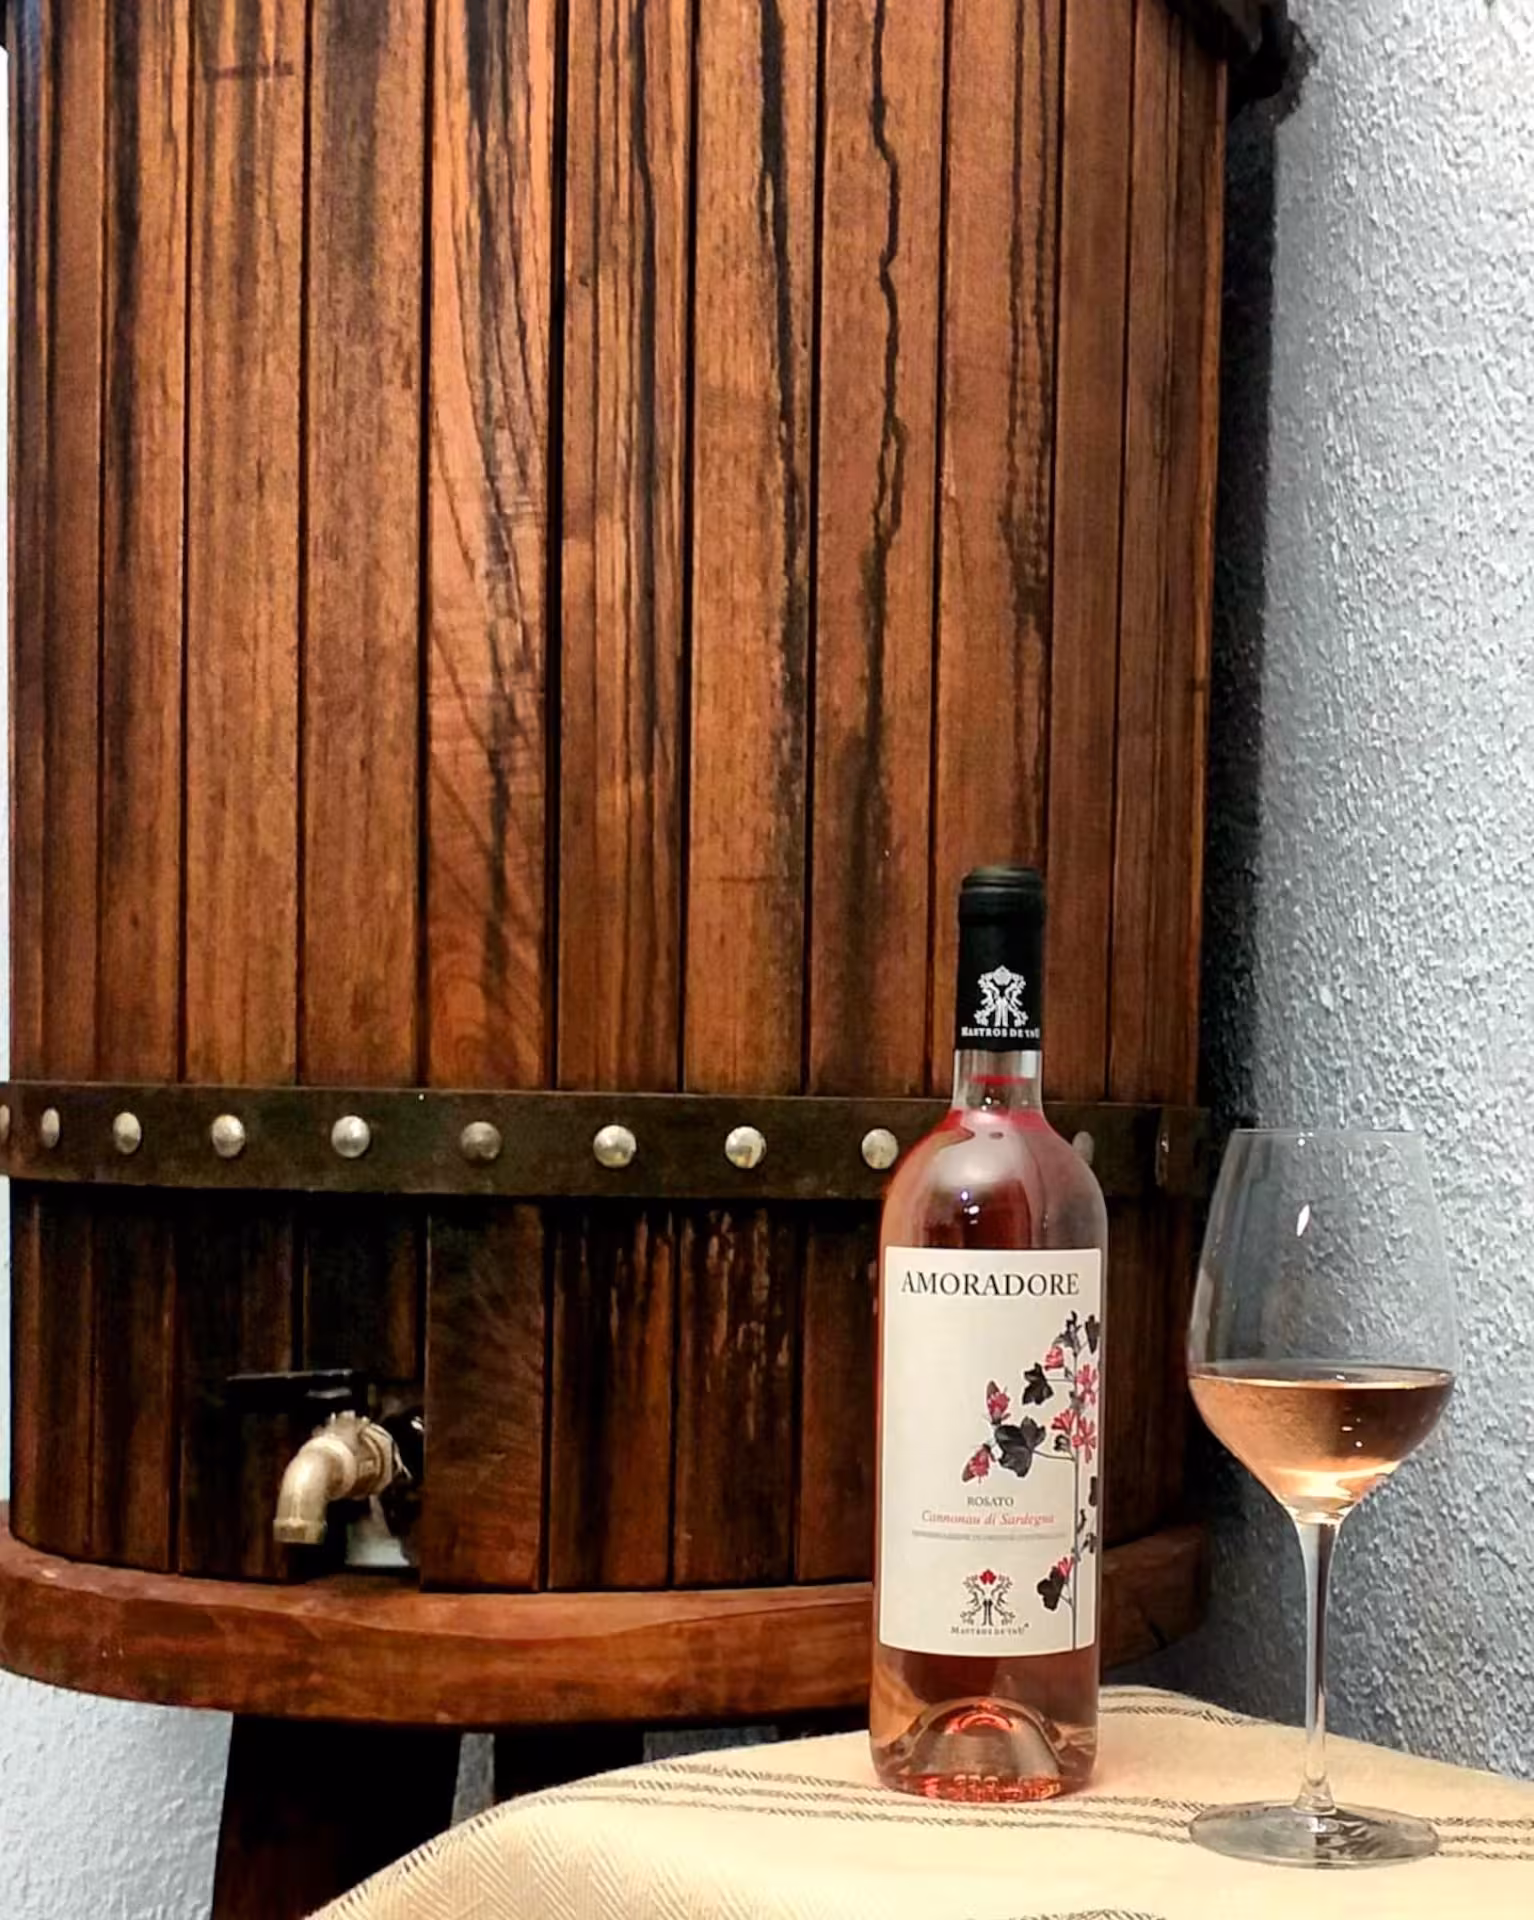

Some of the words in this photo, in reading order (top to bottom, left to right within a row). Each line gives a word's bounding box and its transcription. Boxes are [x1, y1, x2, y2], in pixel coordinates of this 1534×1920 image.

[901, 1270, 1080, 1297] AMORADORE
[967, 1496, 1015, 1507] ROSATO
[921, 1509, 981, 1525] Cannonau
[983, 1512, 997, 1526] di
[999, 1511, 1054, 1527] Sardegna
